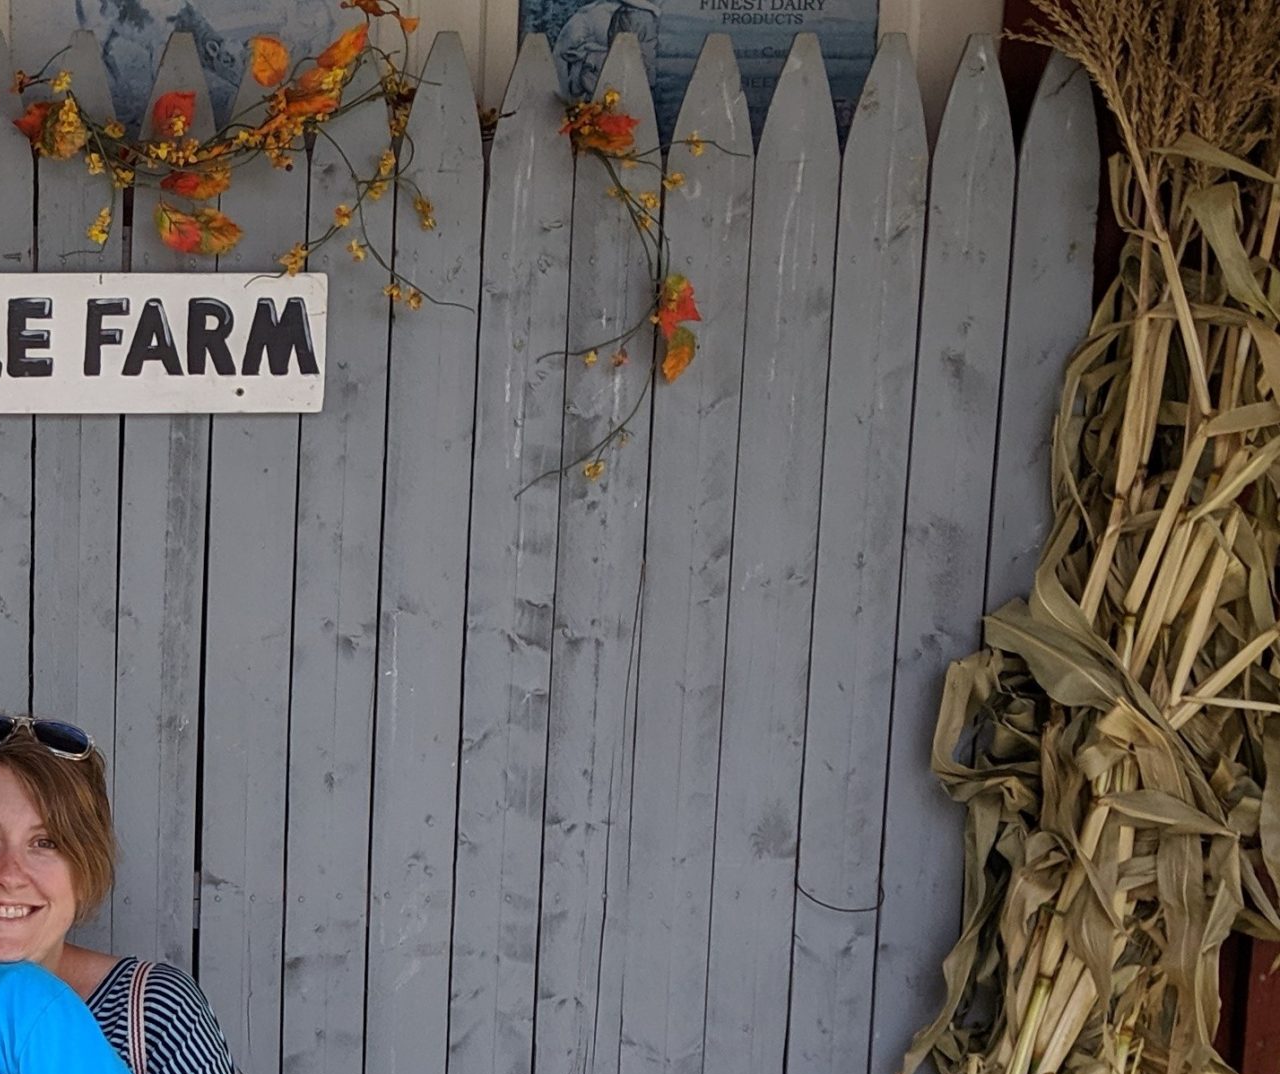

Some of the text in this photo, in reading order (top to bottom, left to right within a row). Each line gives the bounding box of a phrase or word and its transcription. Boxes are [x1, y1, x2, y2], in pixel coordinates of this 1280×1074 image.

[700, 0, 825, 11] FINEST DAIRY
[721, 13, 804, 25] PRODUCTS
[82, 295, 320, 379] FARM
